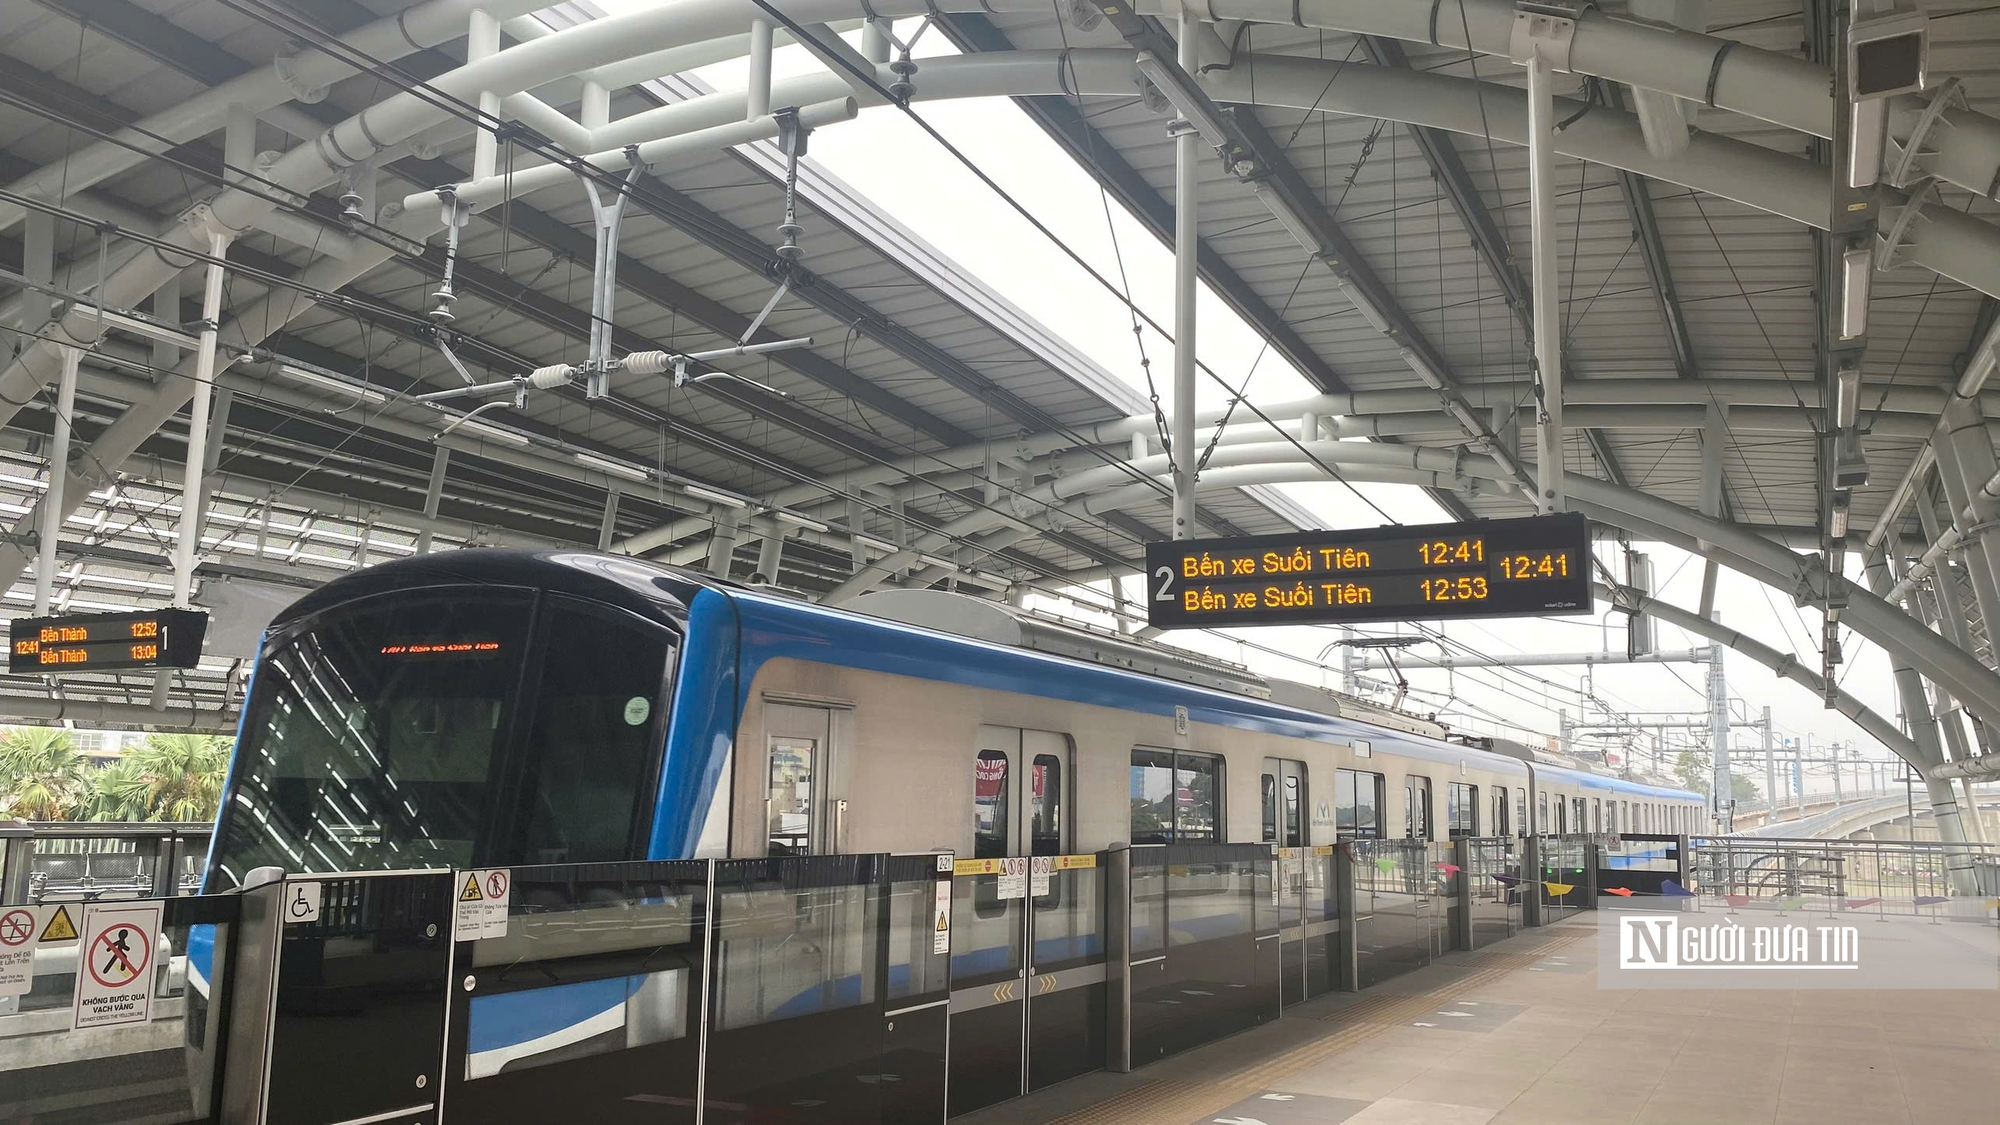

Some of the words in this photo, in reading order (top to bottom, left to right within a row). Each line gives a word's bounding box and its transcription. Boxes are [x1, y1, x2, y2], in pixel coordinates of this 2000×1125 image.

[1183, 552, 1225, 578] Bến
[1231, 558, 1255, 575] xe
[1263, 547, 1312, 573] Suối
[1320, 548, 1370, 570] Tiên
[1419, 540, 1484, 565] 12:41
[1500, 554, 1568, 579] 12:41
[1155, 566, 1175, 601] 2
[1184, 586, 1226, 611] Bến
[1233, 592, 1257, 608] xe
[1264, 581, 1313, 607] Suối
[1321, 584, 1372, 605] Tiên
[1420, 577, 1488, 601] 12:53
[41, 627, 59, 642] Bến
[61, 627, 87, 641] Thành
[131, 622, 157, 637] 12:52
[162, 626, 168, 650] 1
[16, 640, 39, 654] 12:41
[41, 648, 59, 664] Bến
[61, 649, 87, 662] Thành
[131, 645, 157, 660] 13:04
[938, 857, 950, 870] 2-21
[82, 996, 108, 1006] KHÔNG
[109, 994, 130, 1003] BƯỚC
[93, 1005, 113, 1014] VẠCH
[114, 1003, 134, 1011] VÀNG
